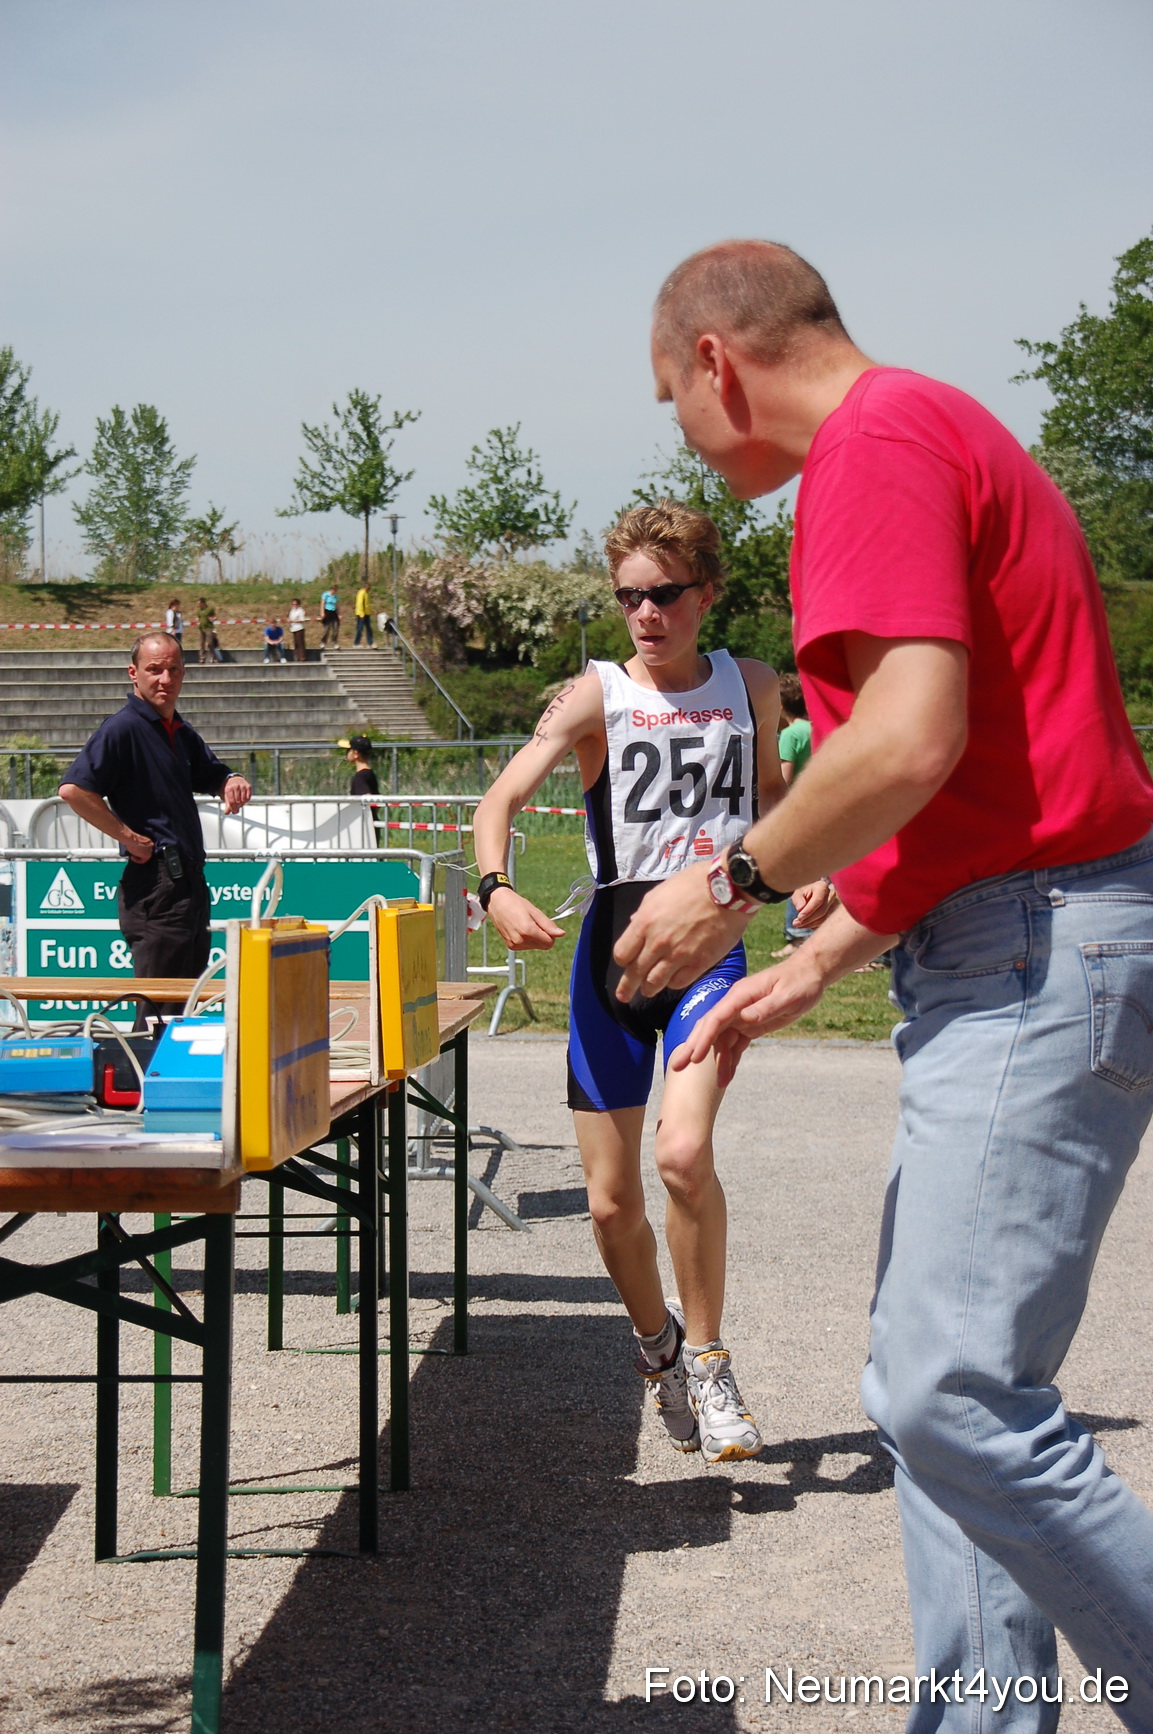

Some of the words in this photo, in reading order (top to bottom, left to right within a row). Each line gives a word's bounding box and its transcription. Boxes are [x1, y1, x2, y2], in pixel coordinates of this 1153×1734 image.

[535, 684, 576, 747] 254
[632, 707, 734, 731] Sparkasse
[621, 734, 746, 824] 254
[40, 939, 97, 969] Fun
[109, 939, 134, 969] &
